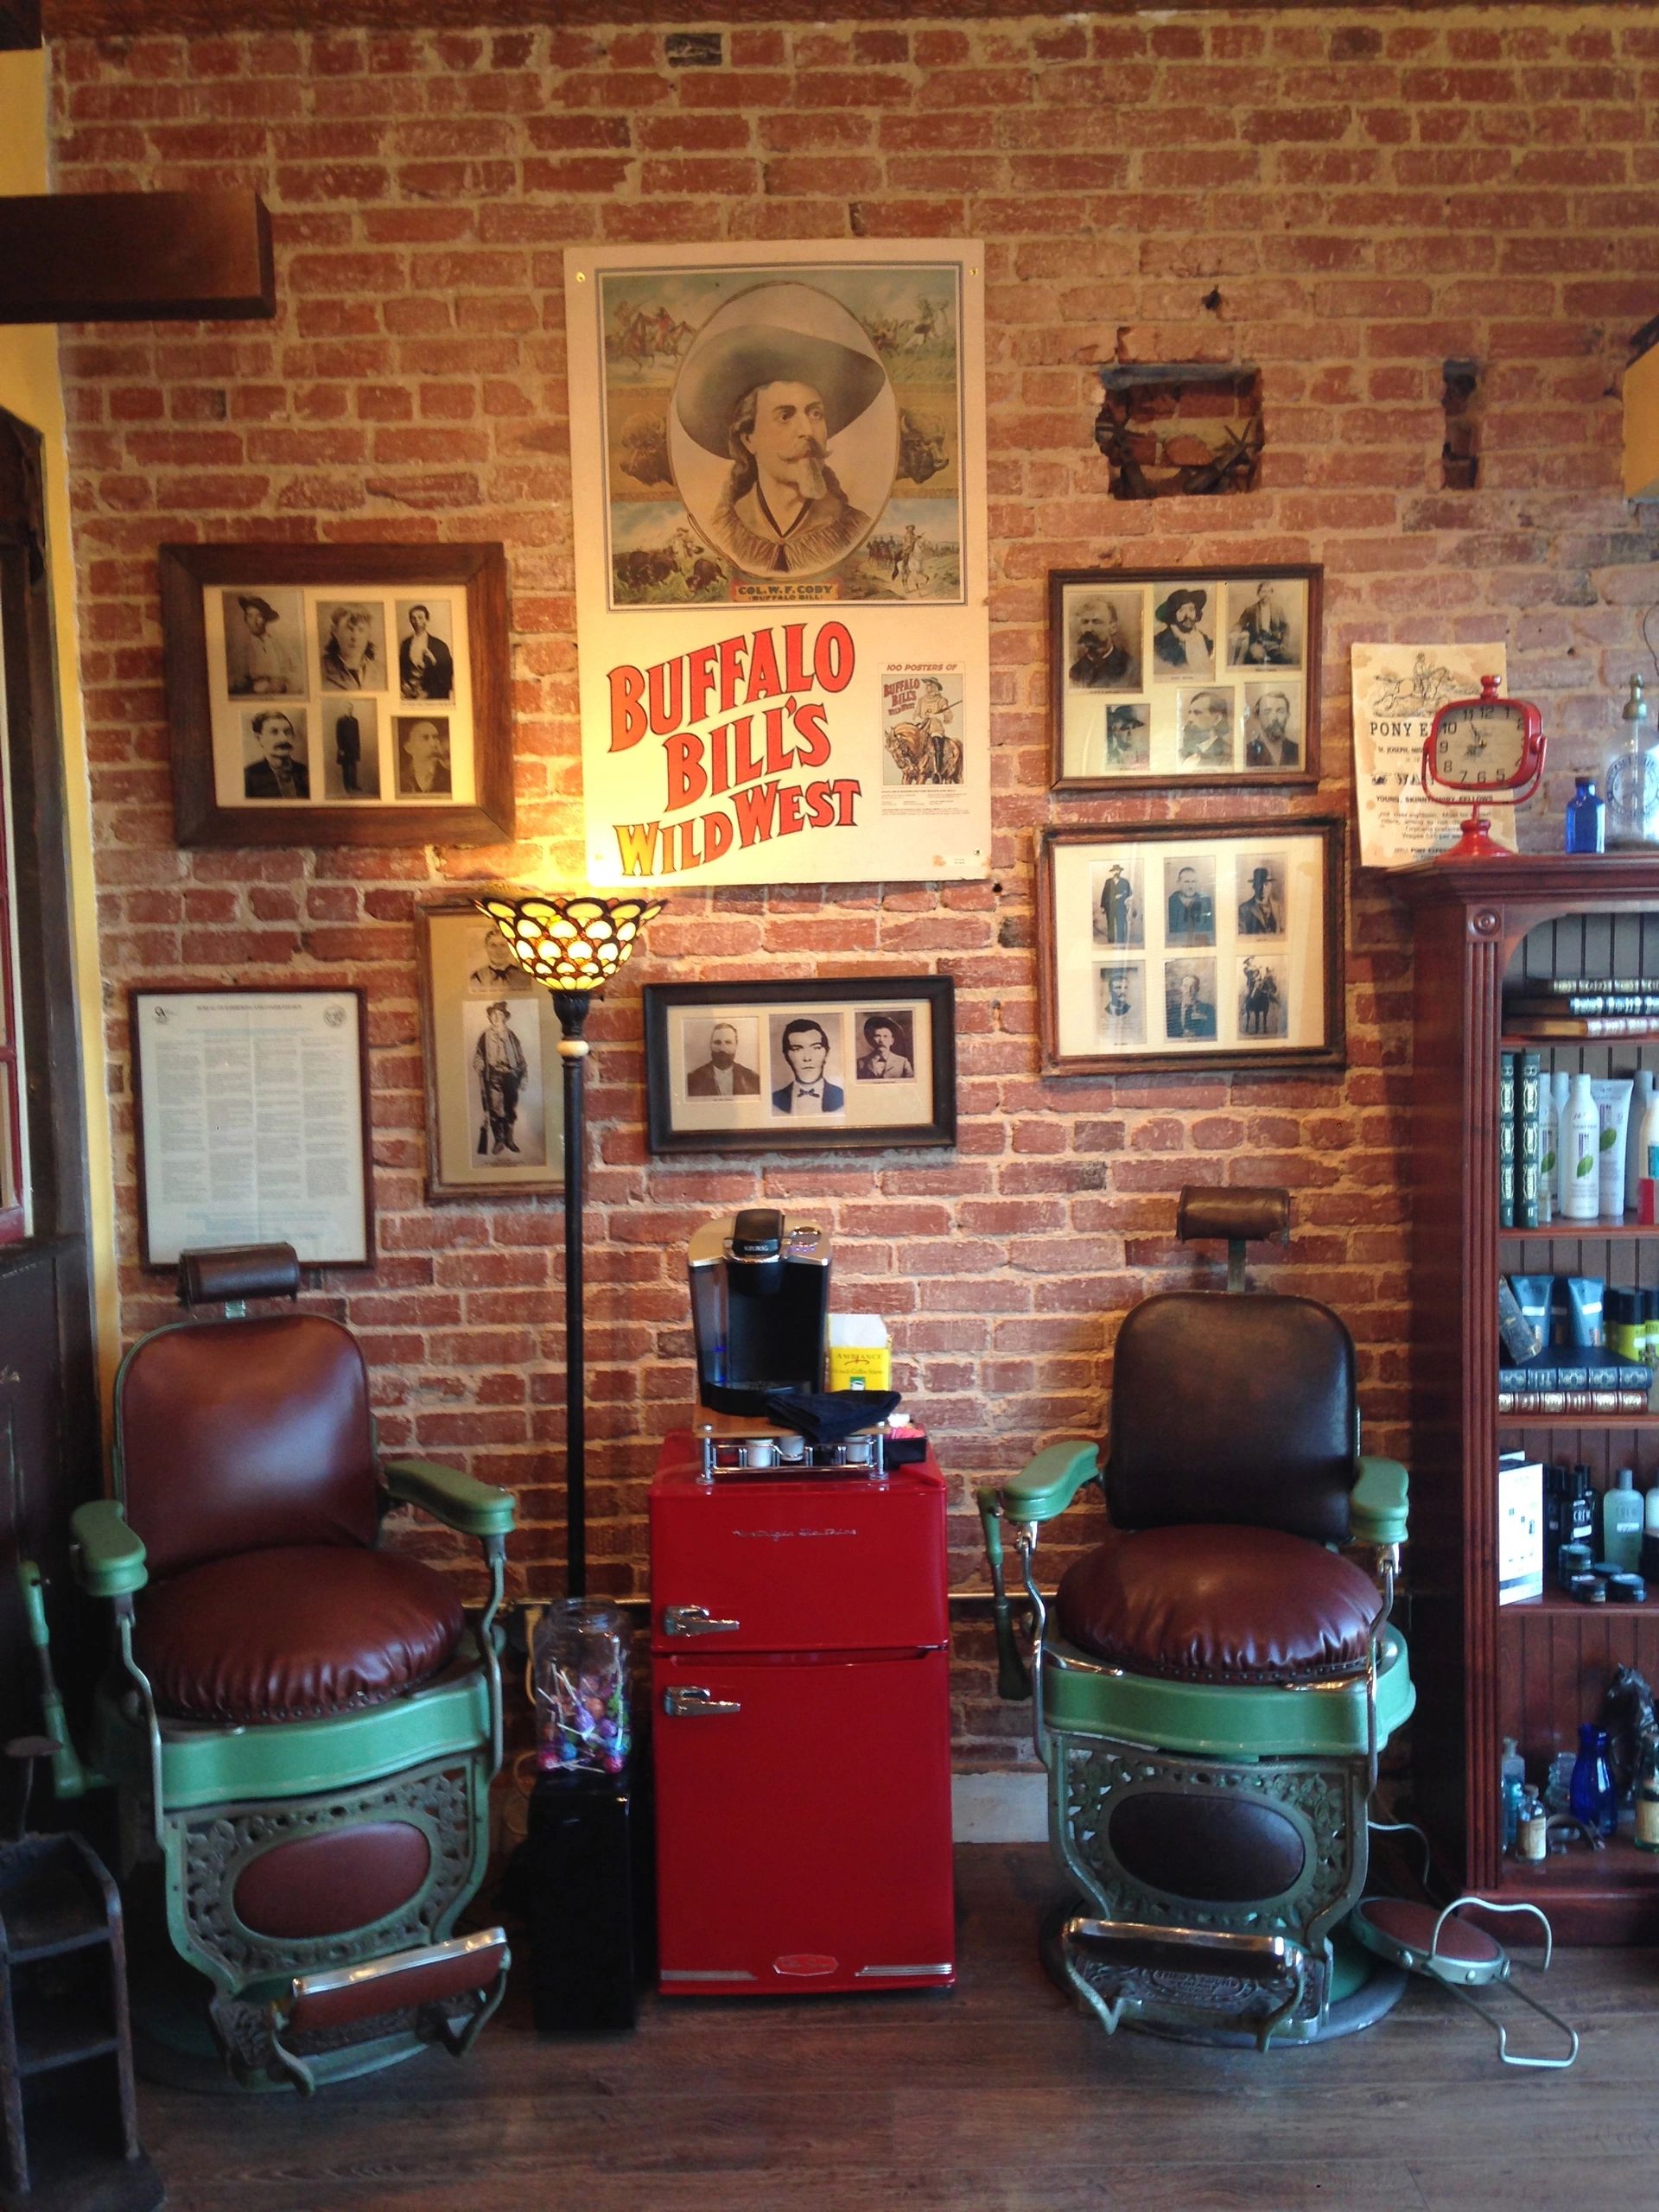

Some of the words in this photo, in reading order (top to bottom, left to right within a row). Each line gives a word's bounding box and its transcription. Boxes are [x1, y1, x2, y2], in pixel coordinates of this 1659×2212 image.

[607, 620, 855, 753] BUFFALO
[883, 678, 920, 698] BUFFALO
[1480, 705, 1494, 719] 12
[1370, 722, 1412, 736] PONY
[1442, 722, 1457, 734] 10
[1440, 741, 1448, 753] 9
[661, 696, 831, 813] BILL'S
[1444, 760, 1452, 773] 8
[1459, 770, 1468, 784] 7
[1478, 771, 1486, 783] 6
[613, 810, 734, 876] WILD
[730, 779, 861, 849] WEST
[1573, 1509, 1591, 1522] CREW
